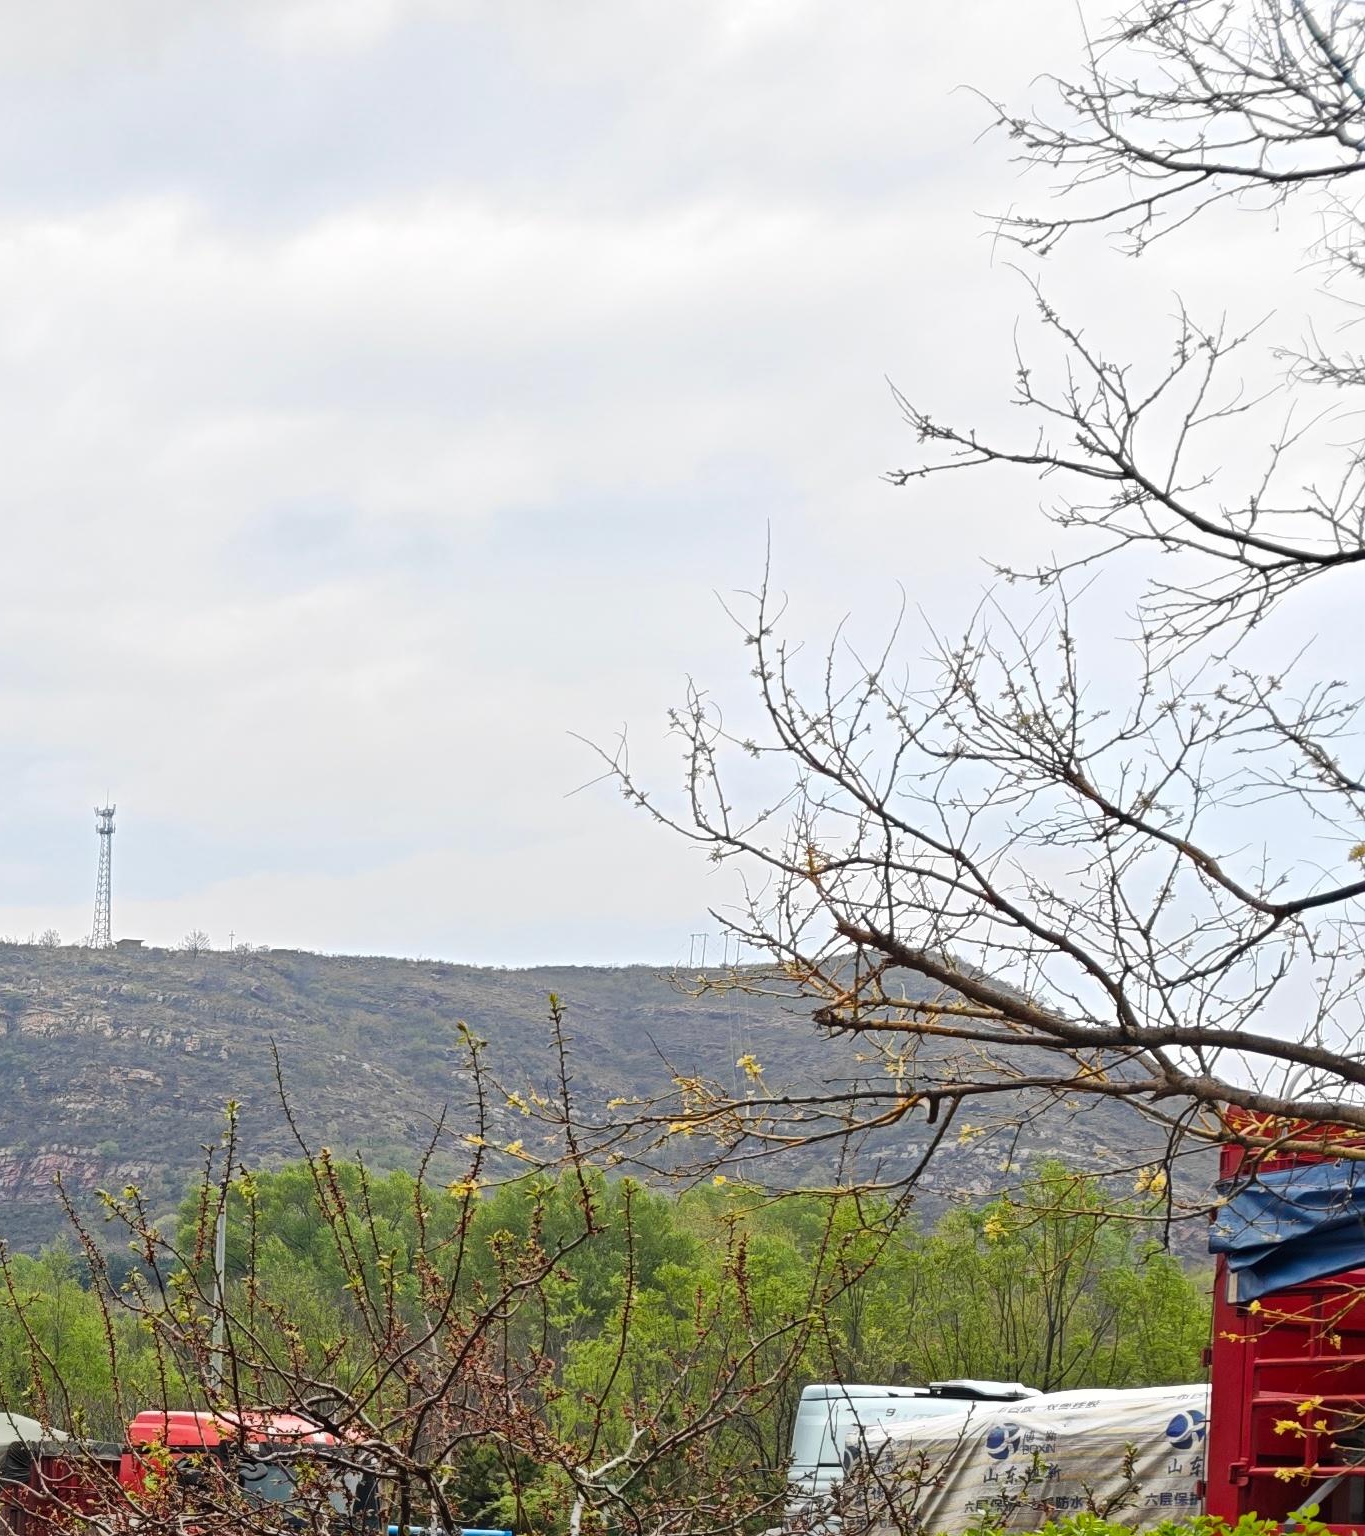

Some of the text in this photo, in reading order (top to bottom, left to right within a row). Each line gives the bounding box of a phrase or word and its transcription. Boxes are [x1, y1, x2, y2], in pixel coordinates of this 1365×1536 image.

[1022, 1443, 1056, 1455] BOXIN
[983, 1462, 1062, 1484] 山东新
[1167, 1455, 1204, 1476] 山东
[964, 1496, 1016, 1513] 六层保
